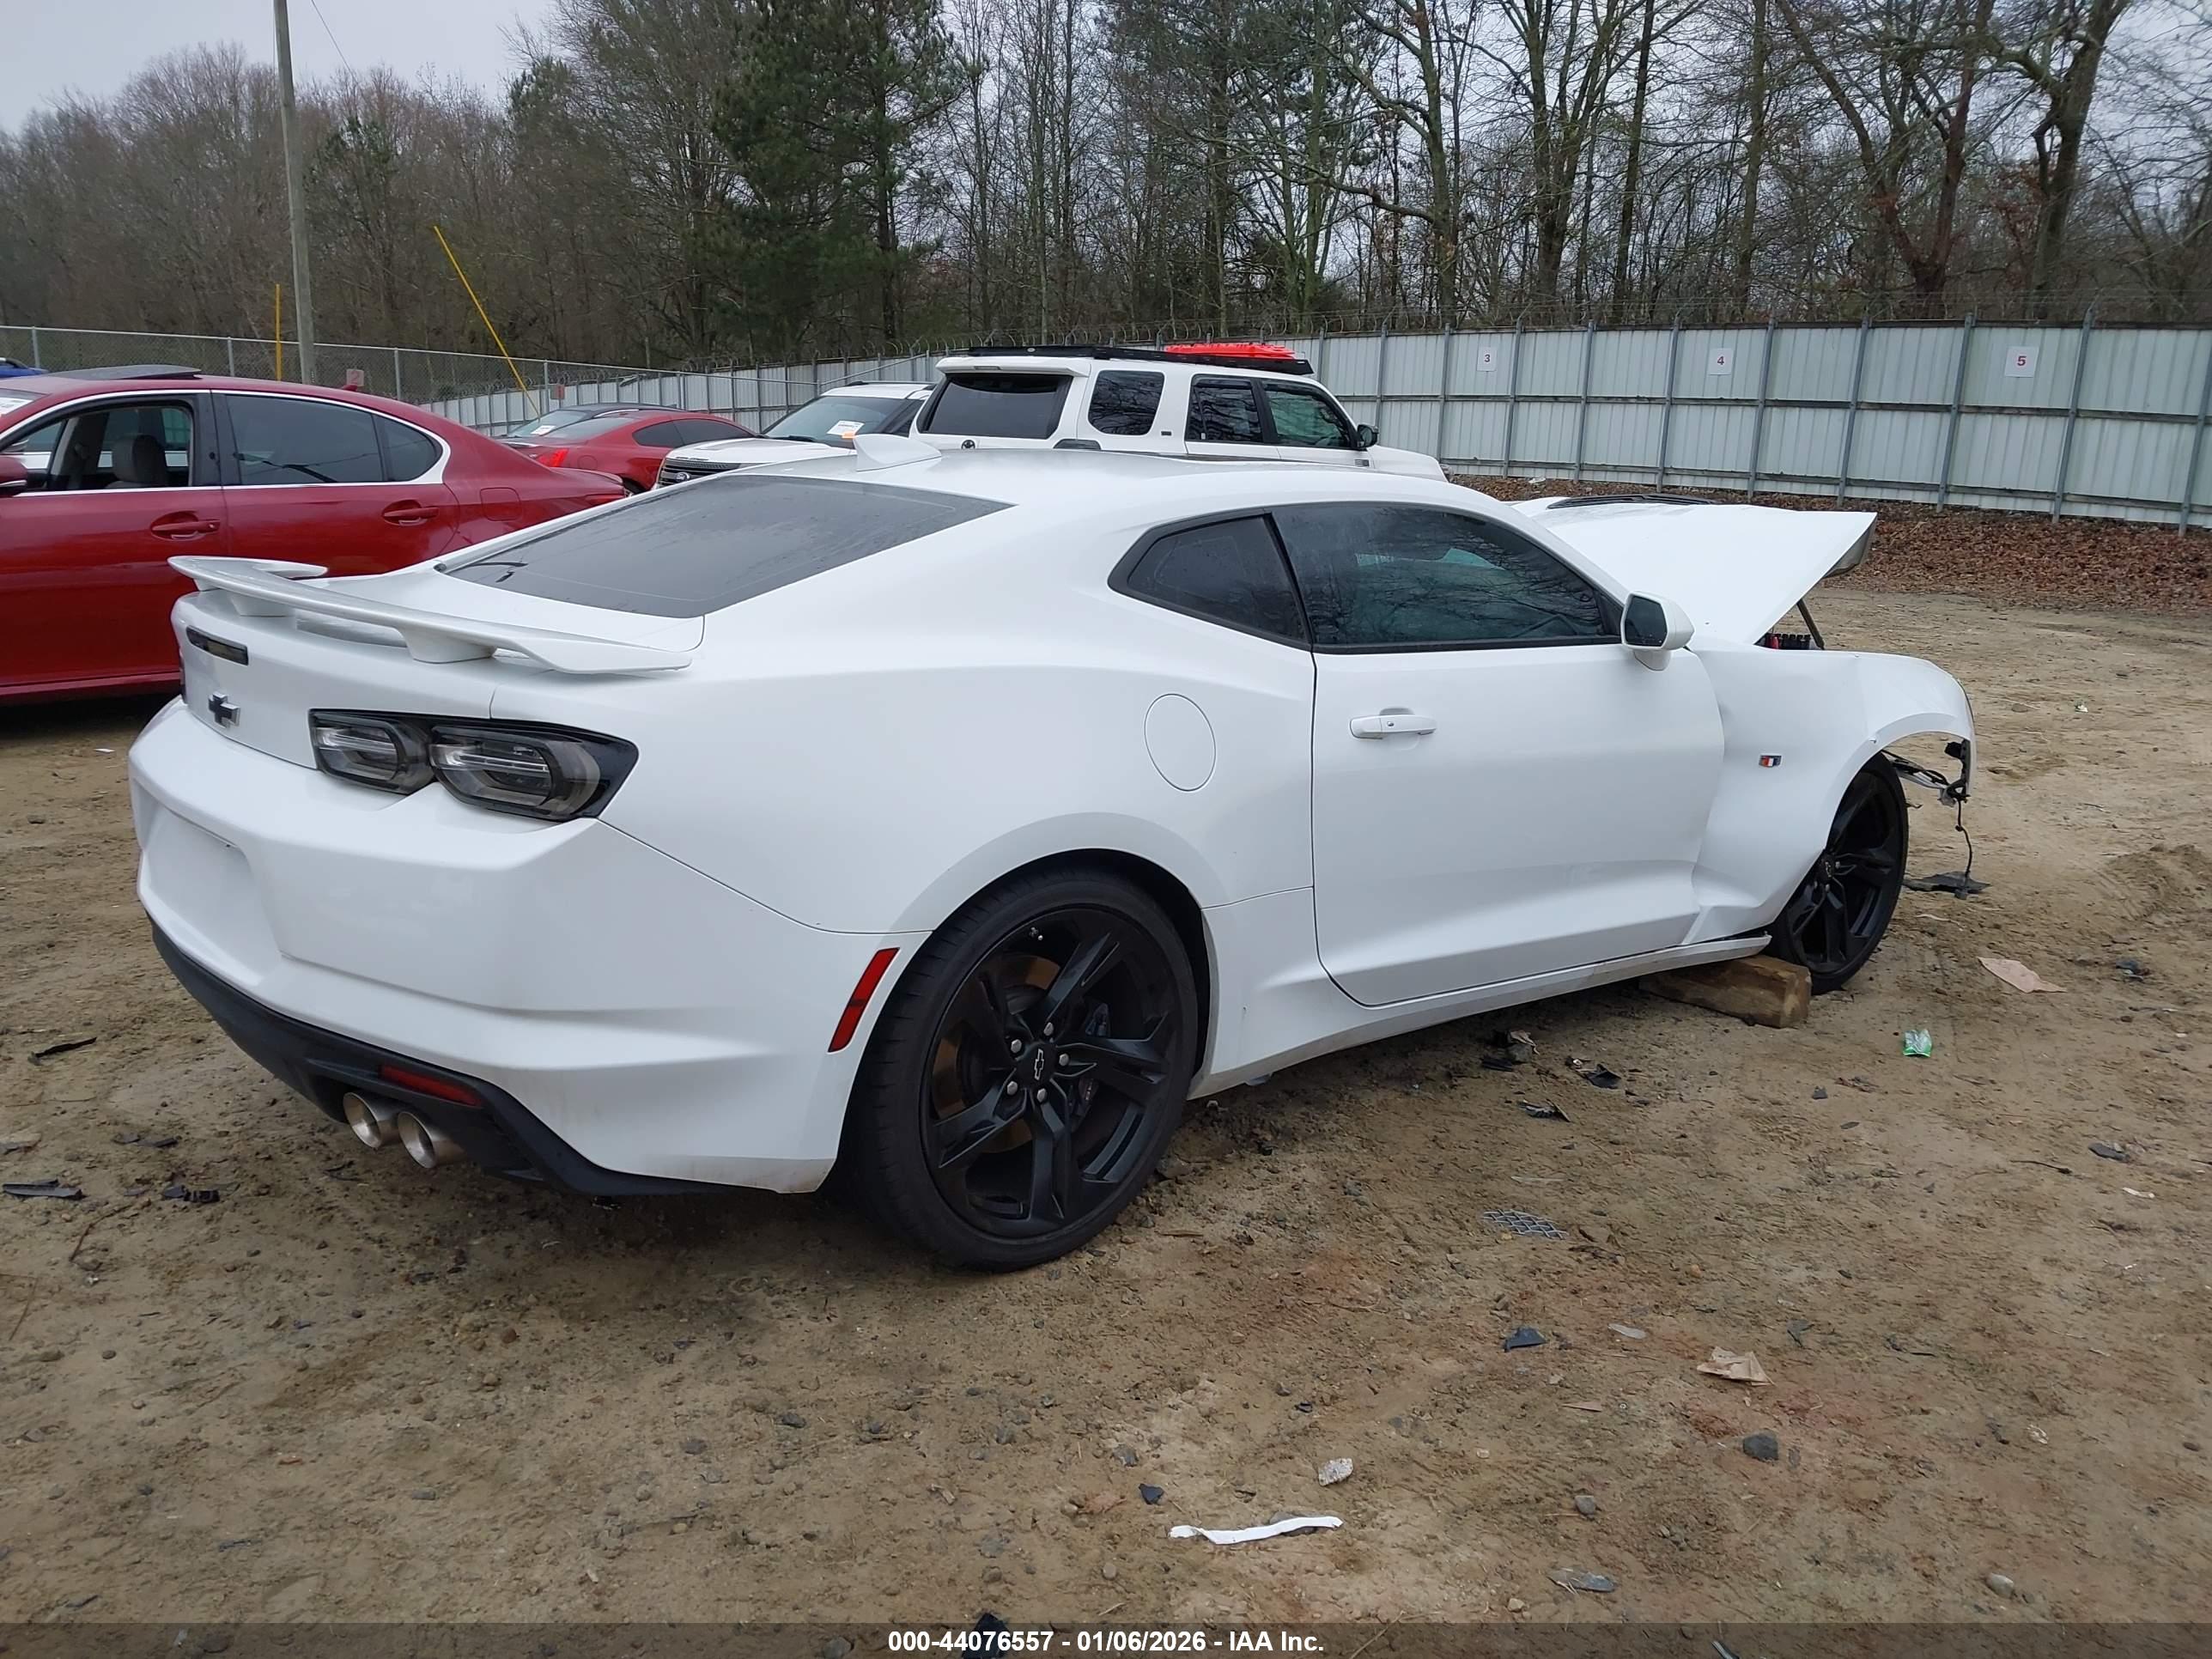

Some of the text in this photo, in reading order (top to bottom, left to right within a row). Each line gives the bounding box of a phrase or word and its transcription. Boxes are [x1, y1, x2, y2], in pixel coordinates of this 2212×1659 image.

[1484, 354, 1491, 362] 3
[1717, 356, 1725, 366] 4
[2017, 356, 2027, 367] 5
